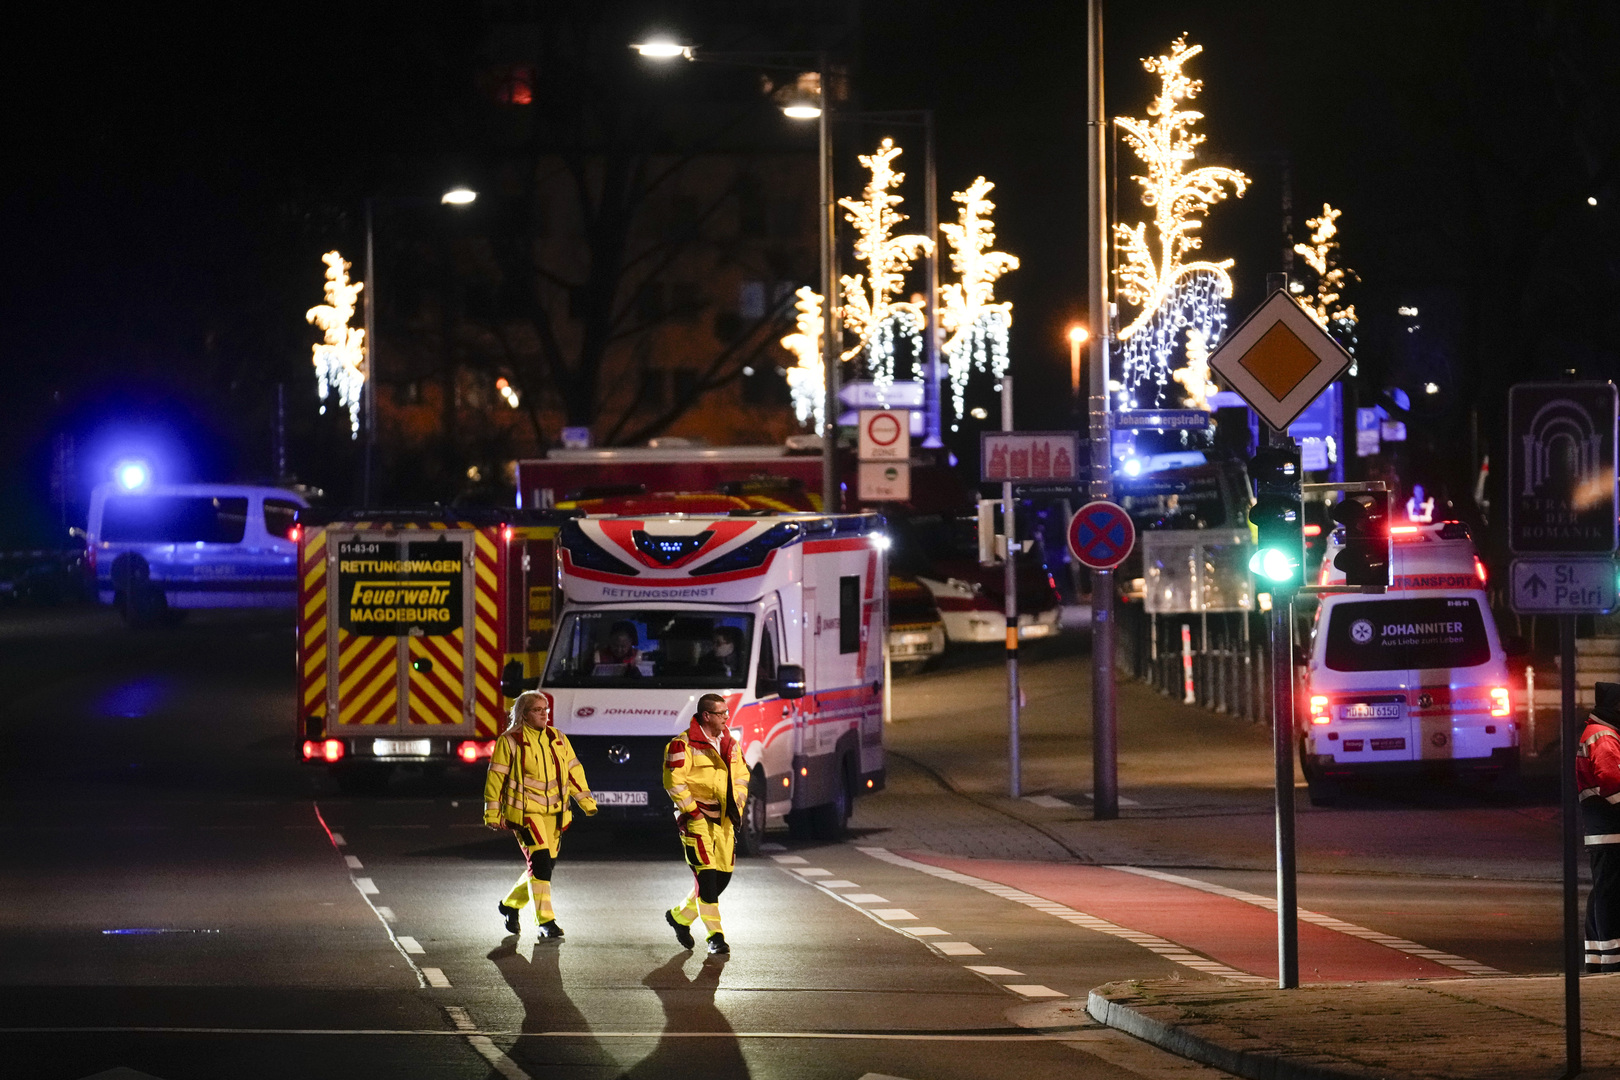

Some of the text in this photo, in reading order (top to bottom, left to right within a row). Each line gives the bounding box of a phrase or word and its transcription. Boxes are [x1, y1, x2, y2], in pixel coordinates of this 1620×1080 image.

[1118, 414, 1205, 427] Johannbergstraße
[340, 560, 461, 573] RETTUNGSWAGEN
[1393, 576, 1473, 587] TRANSPORT
[350, 581, 451, 605] Feuerwehr
[602, 586, 718, 598] RETTUNGSDIENST
[1555, 586, 1602, 605] Petri
[350, 608, 451, 622] MAGDEBURG
[1381, 621, 1463, 636] JOHANNITER
[1381, 637, 1397, 646] Aus
[1398, 637, 1420, 645] Liebe
[1439, 636, 1464, 644] Leben
[604, 708, 679, 716] JOHANNITER
[594, 793, 605, 803] MD
[625, 793, 648, 803] 7103
